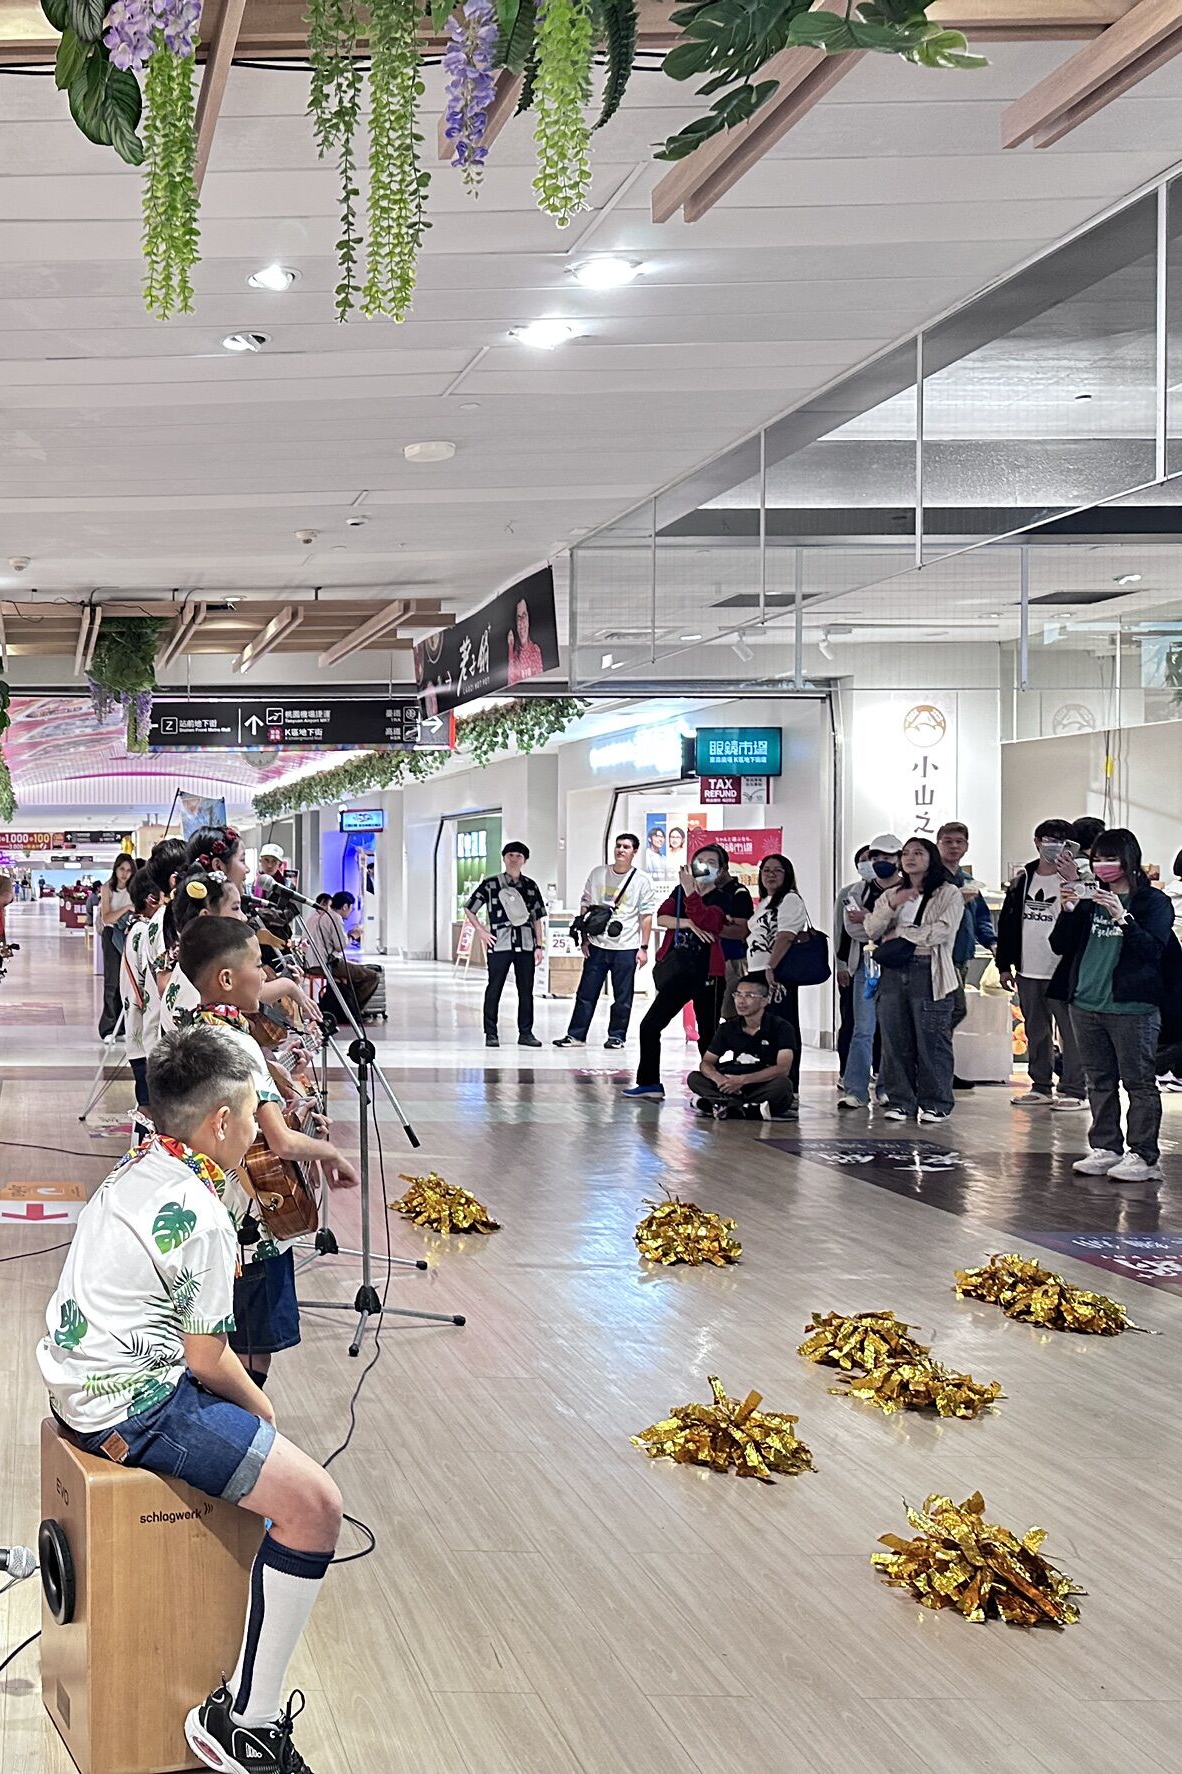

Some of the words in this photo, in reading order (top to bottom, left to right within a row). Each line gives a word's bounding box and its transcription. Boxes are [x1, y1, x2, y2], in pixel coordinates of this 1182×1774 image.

[285, 728, 323, 736] K區地下街
[709, 741, 768, 755] 眼鏡市場
[708, 779, 733, 789] TAX
[704, 790, 737, 798] REFUND
[912, 756, 938, 834] 小山之
[5, 833, 29, 844] 1,000
[33, 833, 49, 843] 100
[140, 1508, 202, 1524] schlagwerk
